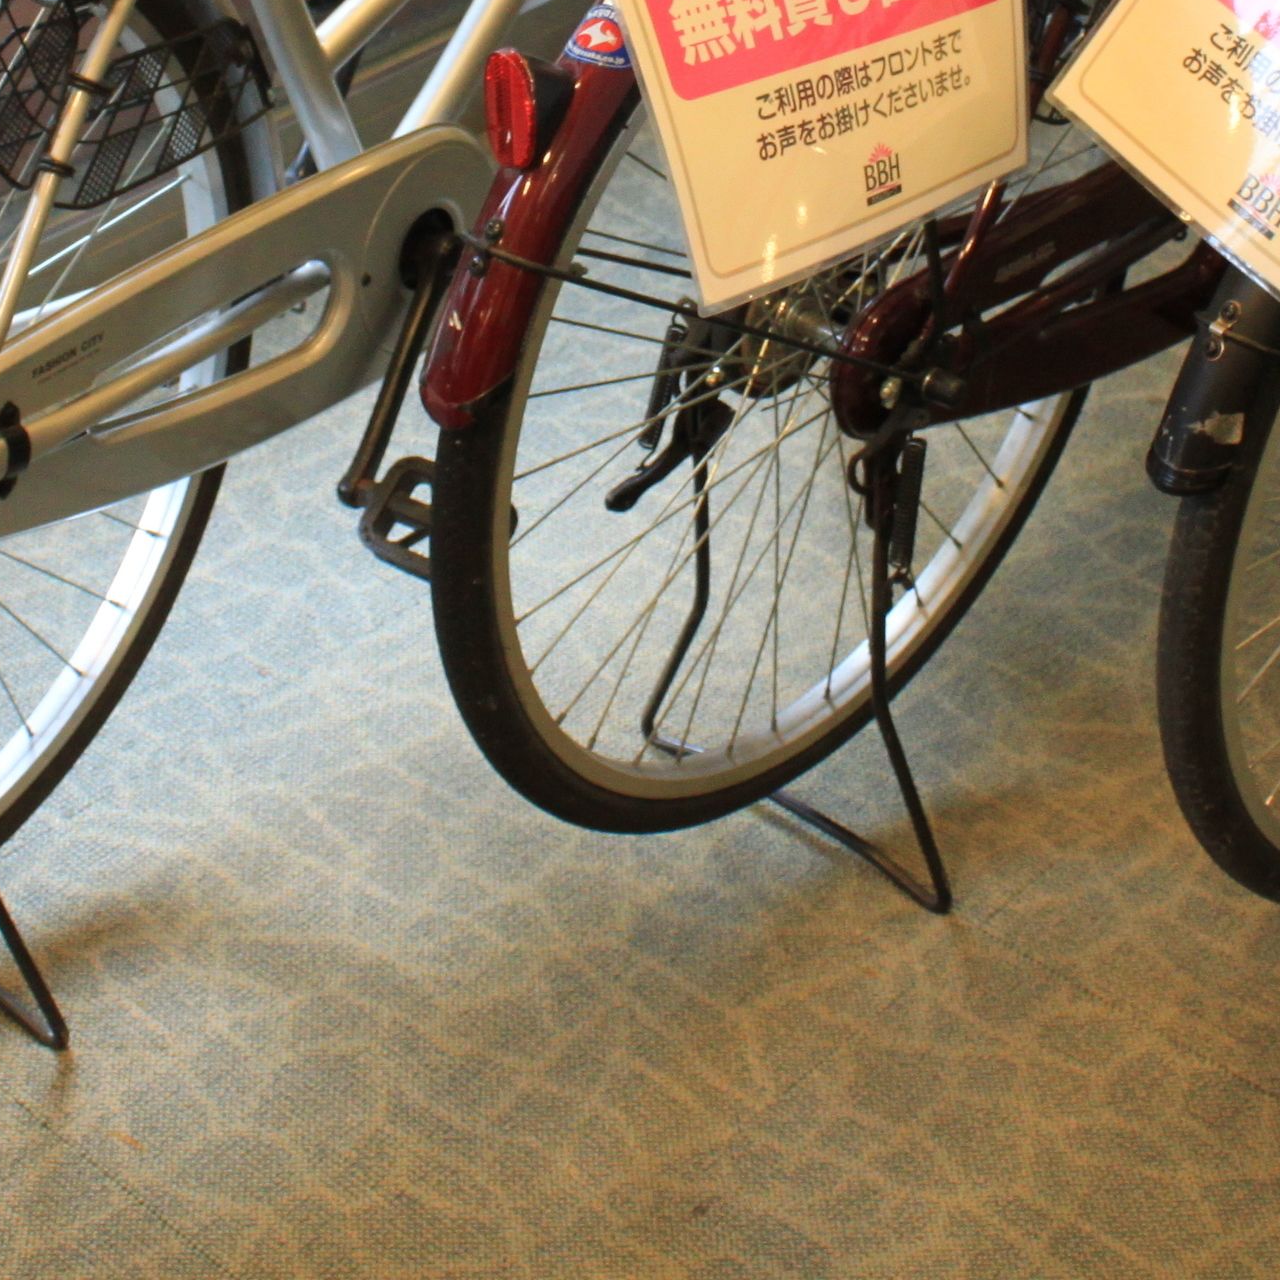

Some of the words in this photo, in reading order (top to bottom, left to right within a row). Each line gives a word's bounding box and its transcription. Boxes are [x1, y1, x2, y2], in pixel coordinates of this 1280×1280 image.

[755, 29, 964, 122] ご利用の際はフロントまで
[757, 71, 972, 161] お声をお掛けくださいませ。
[864, 152, 900, 191] BBH
